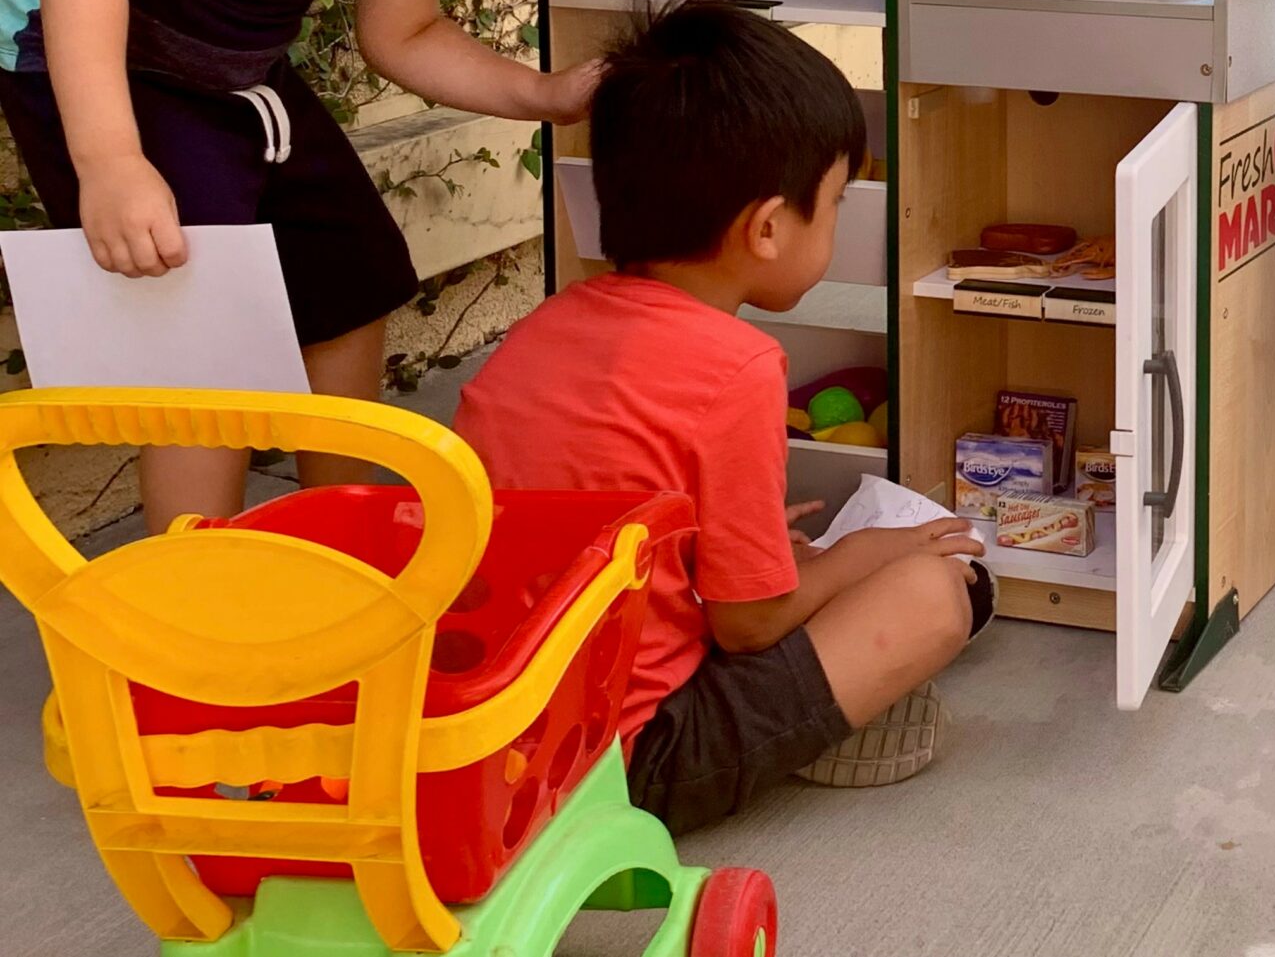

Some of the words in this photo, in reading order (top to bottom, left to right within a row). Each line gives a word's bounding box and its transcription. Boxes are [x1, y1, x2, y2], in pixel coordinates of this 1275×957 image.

[1219, 129, 1274, 208] Fresh
[973, 296, 1022, 310] Meat/Fish
[1072, 305, 1106, 316] Frozen
[1000, 396, 1009, 404] 12
